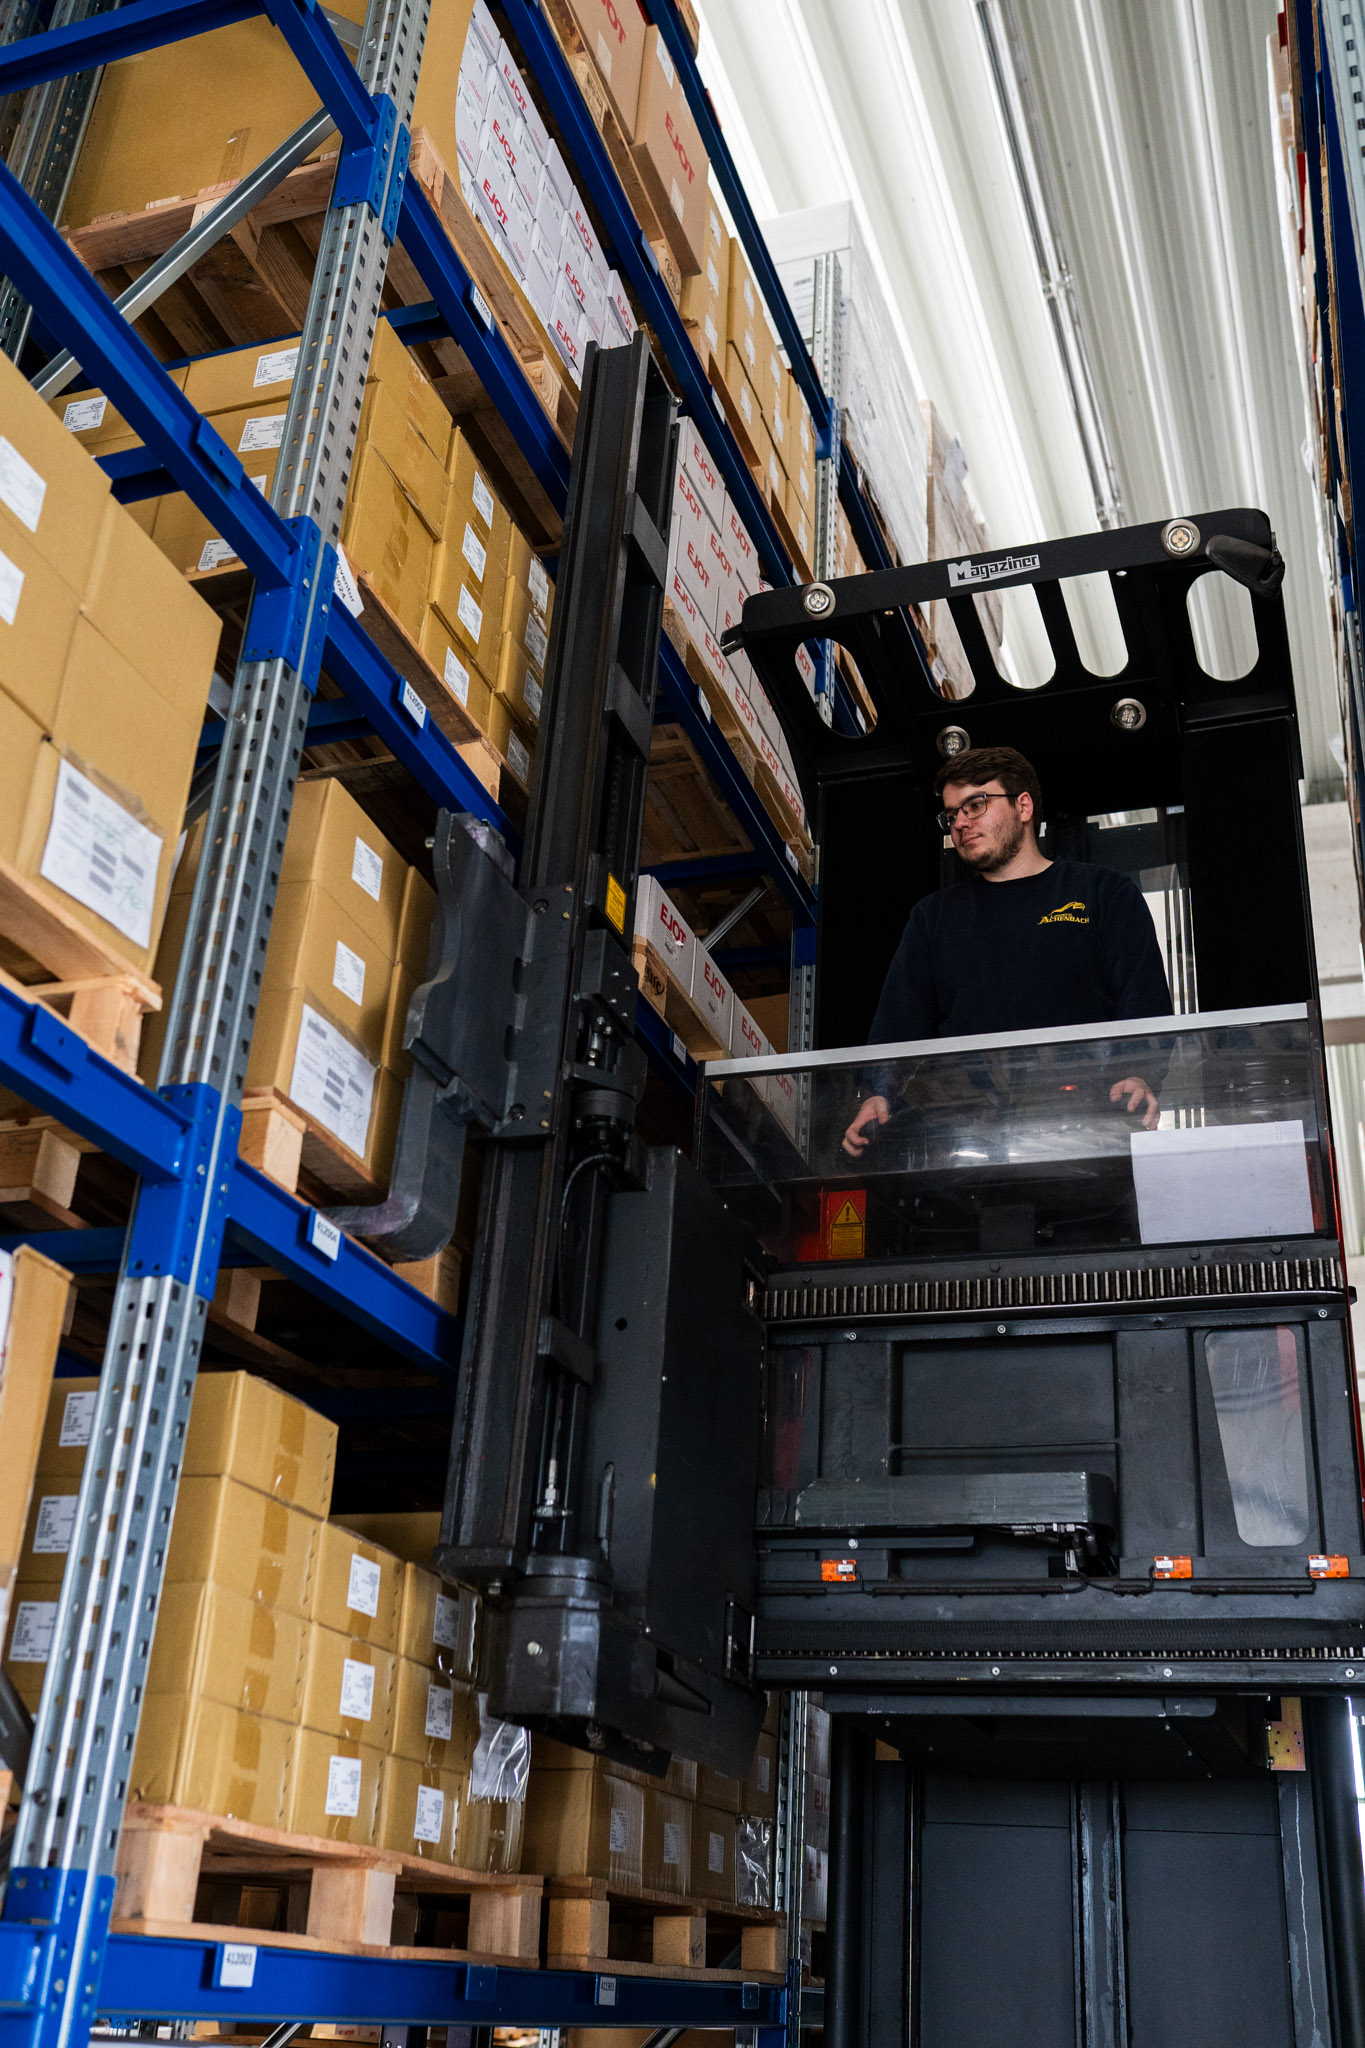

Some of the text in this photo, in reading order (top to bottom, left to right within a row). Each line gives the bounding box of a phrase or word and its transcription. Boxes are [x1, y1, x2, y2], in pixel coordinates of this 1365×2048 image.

[504, 64, 527, 111] EJOT
[493, 119, 517, 166] EJOT
[665, 111, 695, 184] EJOT
[482, 178, 509, 225] EJOT
[575, 210, 594, 251] EJOT
[565, 262, 586, 303] EJOT
[617, 294, 632, 331] EJOT
[556, 319, 579, 360] EJOT
[693, 443, 716, 490] EJOT
[679, 473, 702, 521] EJOT
[710, 532, 733, 578] EJOT
[730, 514, 751, 559] EJOT
[687, 541, 710, 588] EJOT
[947, 554, 1040, 588] Magaziner
[674, 575, 697, 622] EJOT
[705, 633, 726, 678] EJOT
[735, 687, 755, 728] EJOT
[761, 736, 779, 777] EJOT
[785, 783, 802, 821] EJOT
[660, 902, 686, 949] EJOT
[704, 961, 726, 1005] EJOT
[742, 1015, 761, 1056] EJOT
